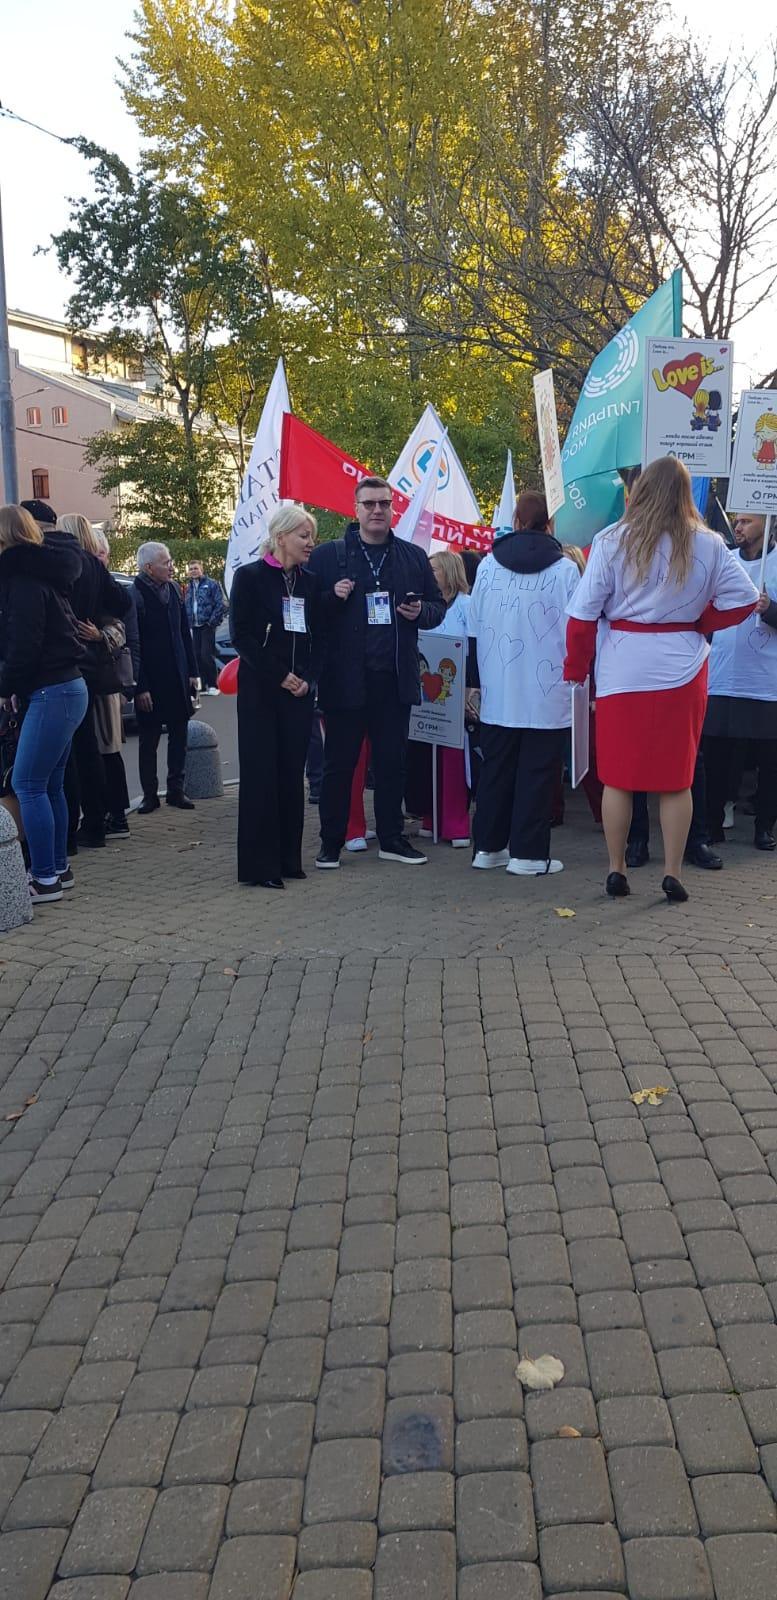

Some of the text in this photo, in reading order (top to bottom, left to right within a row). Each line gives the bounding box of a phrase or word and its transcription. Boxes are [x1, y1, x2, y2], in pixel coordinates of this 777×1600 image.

[651, 365, 699, 393] Love
[677, 452, 695, 460] ГРМ
[499, 595, 522, 613] НА
